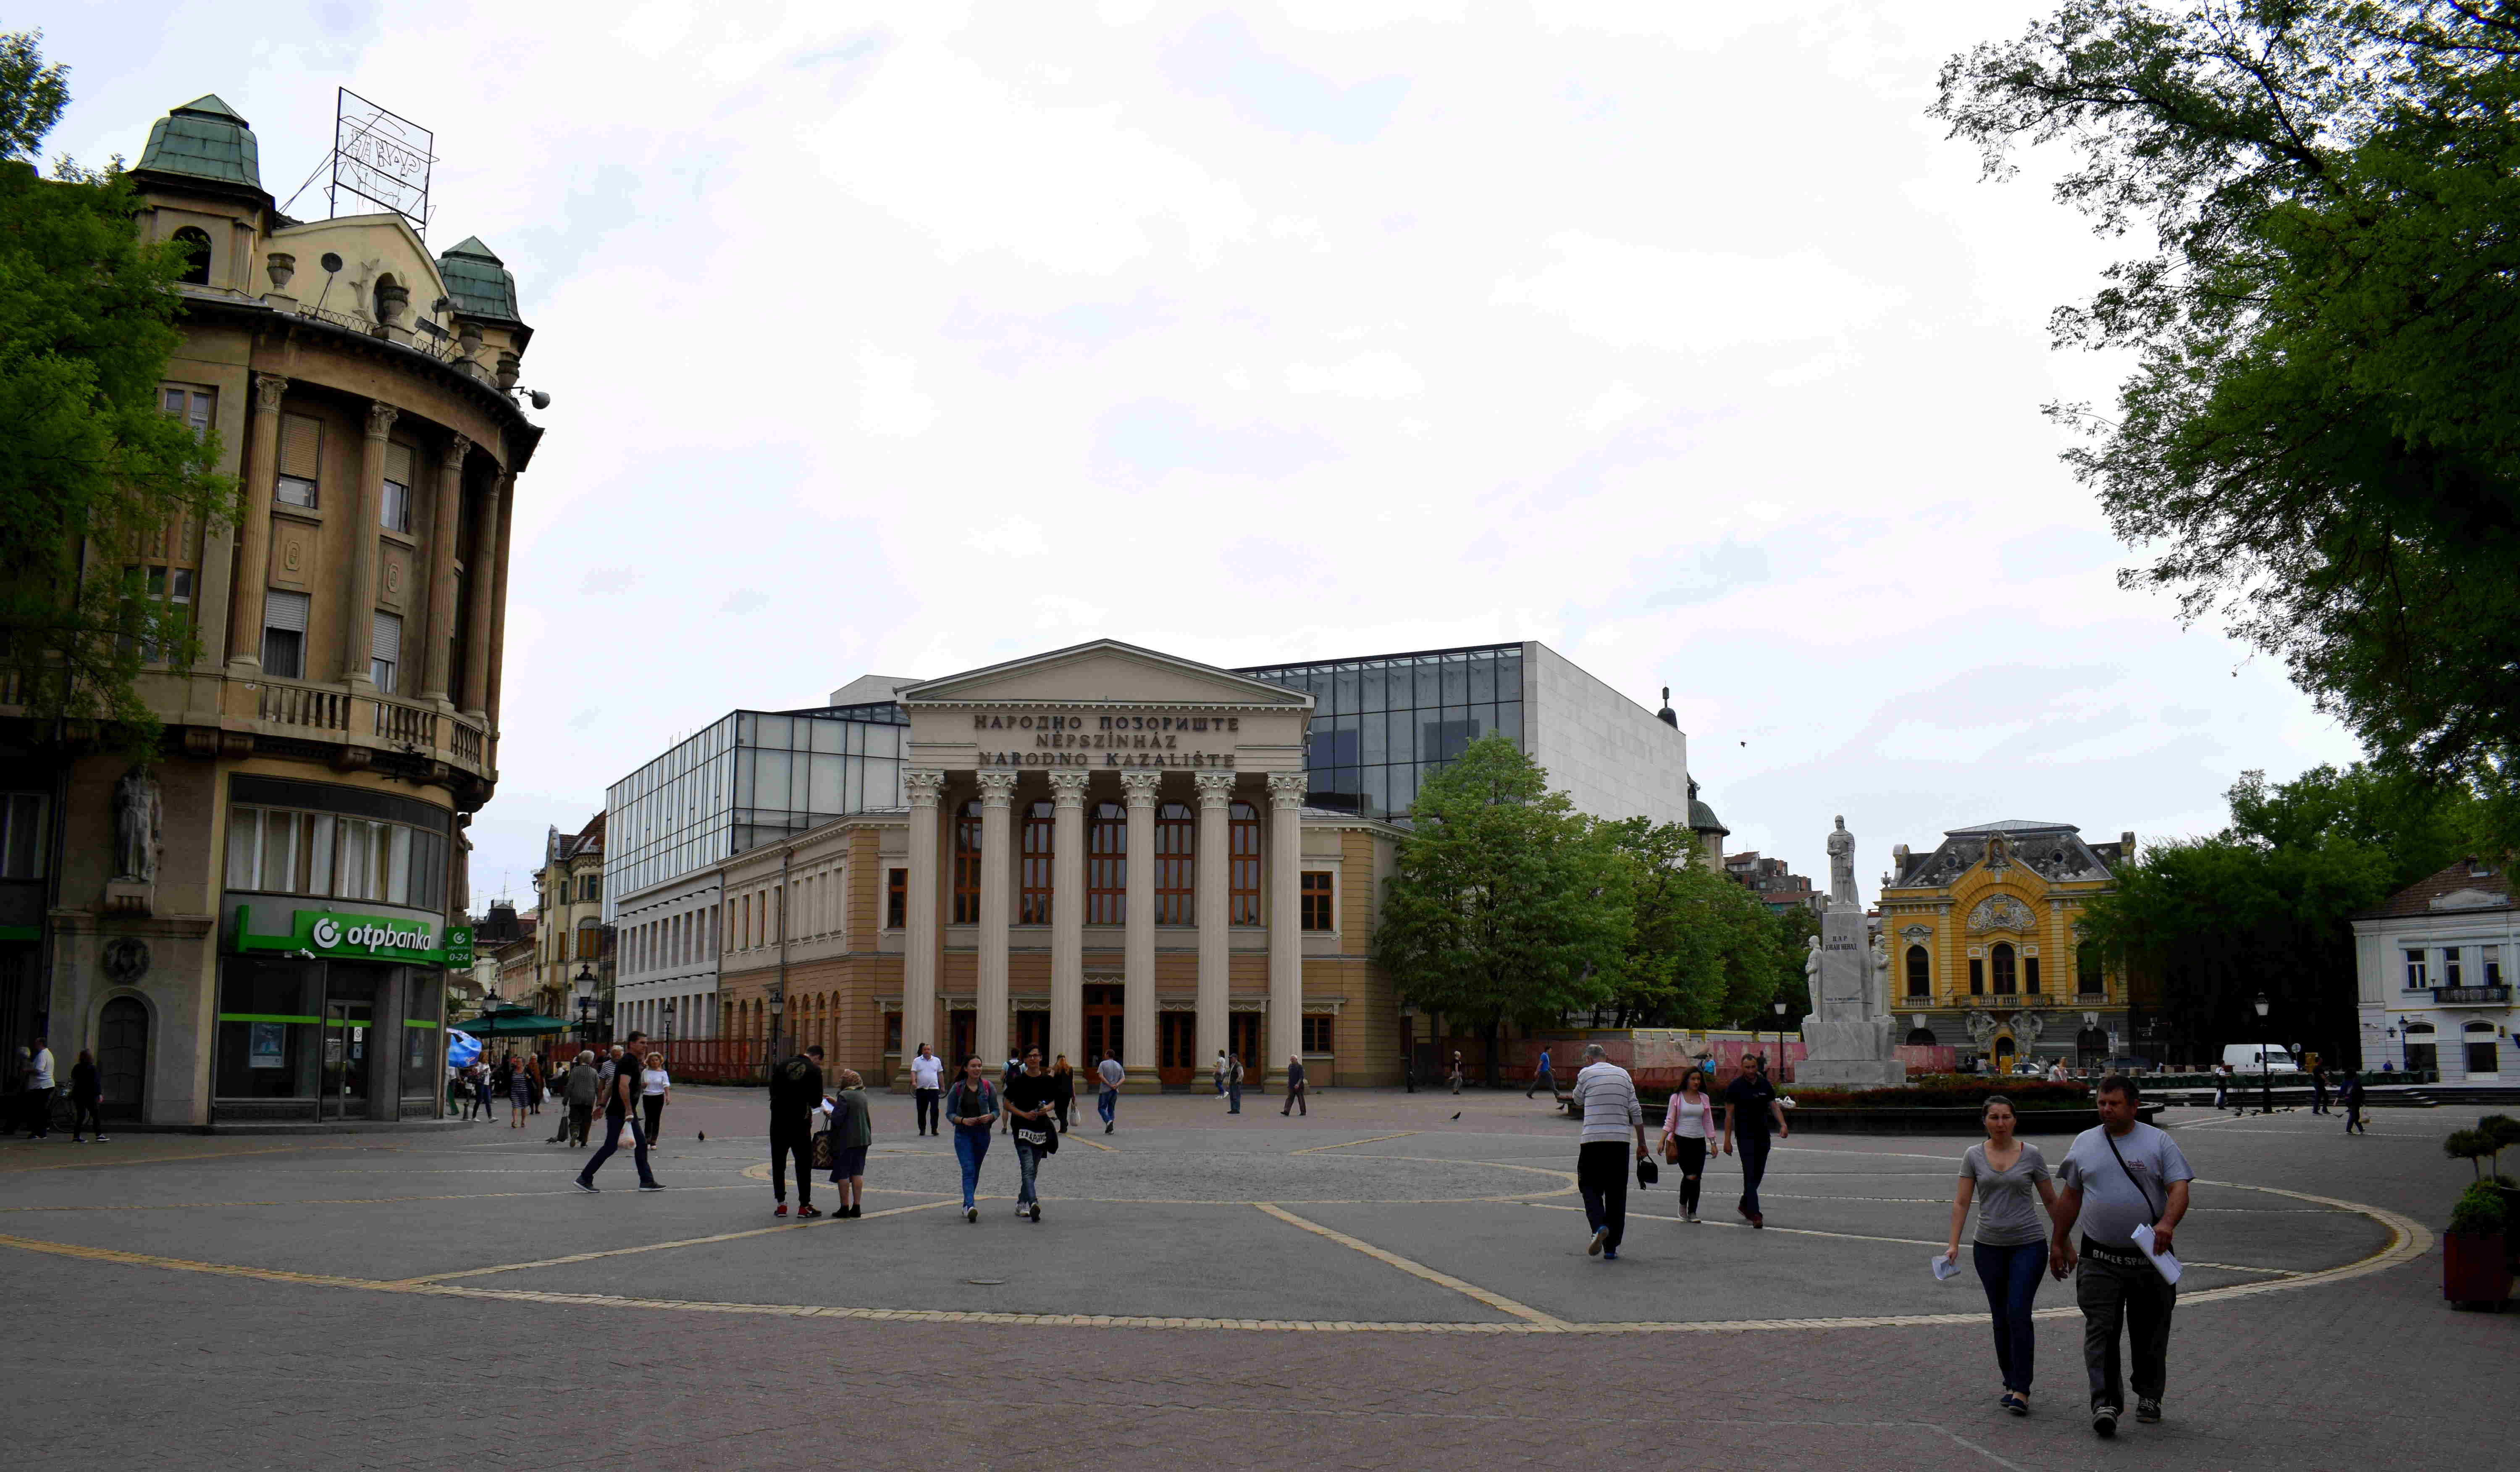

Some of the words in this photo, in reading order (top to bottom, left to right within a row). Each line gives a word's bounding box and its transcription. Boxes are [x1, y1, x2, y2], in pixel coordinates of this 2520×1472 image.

[974, 715, 1082, 730] НАРОДНО
[1099, 716, 1239, 730] ПОЗОРИШТЕ
[1036, 731, 1176, 748] NÉPSZÍNHÁZ
[979, 752, 1088, 765] NARODNO
[1106, 750, 1235, 767] KAZALIŠTE
[347, 923, 431, 952] otpbanka
